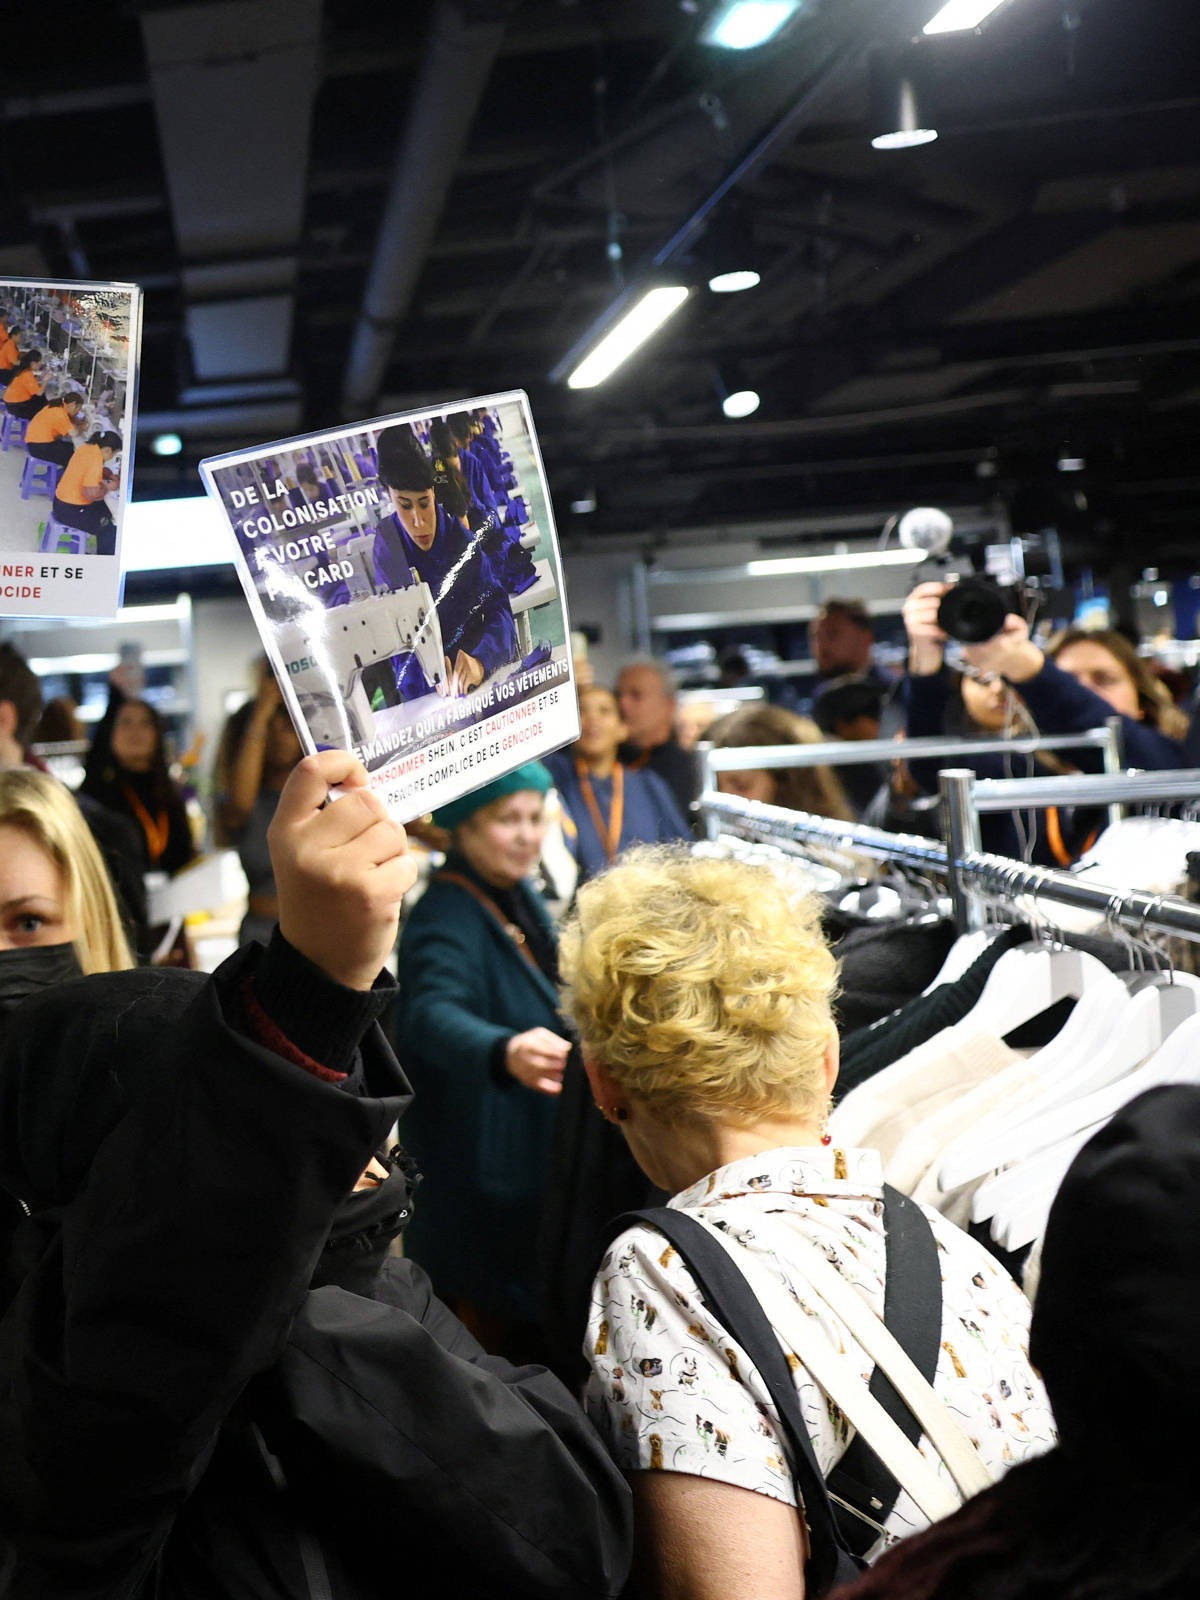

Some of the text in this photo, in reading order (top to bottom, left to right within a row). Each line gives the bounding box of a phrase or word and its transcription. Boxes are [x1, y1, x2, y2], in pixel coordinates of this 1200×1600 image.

[230, 479, 289, 509] DE LA
[243, 487, 380, 538] COLONISATION
[273, 531, 337, 564] VOTRE
[40, 567, 59, 578] ET
[64, 568, 84, 579] SE
[496, 684, 516, 702] VOS
[517, 659, 569, 693] VÊTEMENTS
[460, 726, 483, 748] C'EST
[485, 701, 537, 735] CAUTIONNER
[539, 694, 548, 710] ET
[550, 690, 559, 705] SE
[428, 753, 473, 787] COMPLICE
[477, 747, 487, 764] DE
[490, 741, 500, 758] CE
